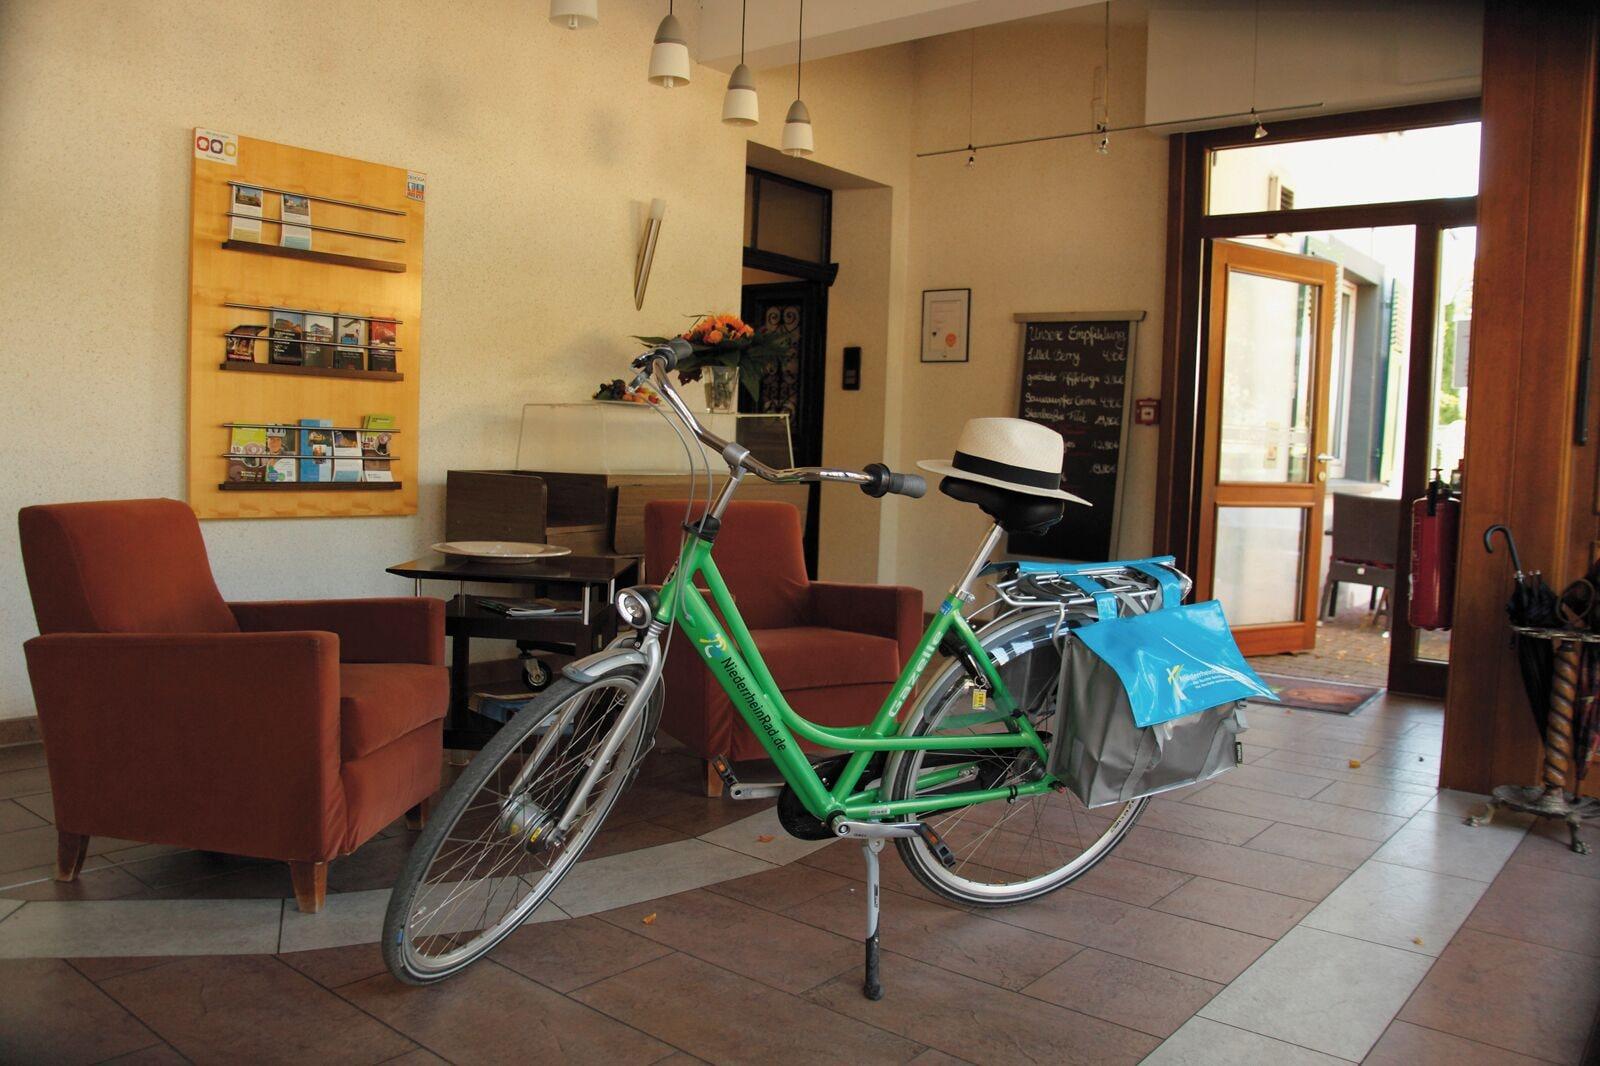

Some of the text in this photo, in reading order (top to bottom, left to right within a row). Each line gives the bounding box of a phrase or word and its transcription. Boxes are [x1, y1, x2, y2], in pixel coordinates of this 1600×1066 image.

[1067, 325, 1126, 350] Empfehlung
[721, 656, 786, 751] NiederrheinRad.de
[888, 631, 944, 717] Gazelle
